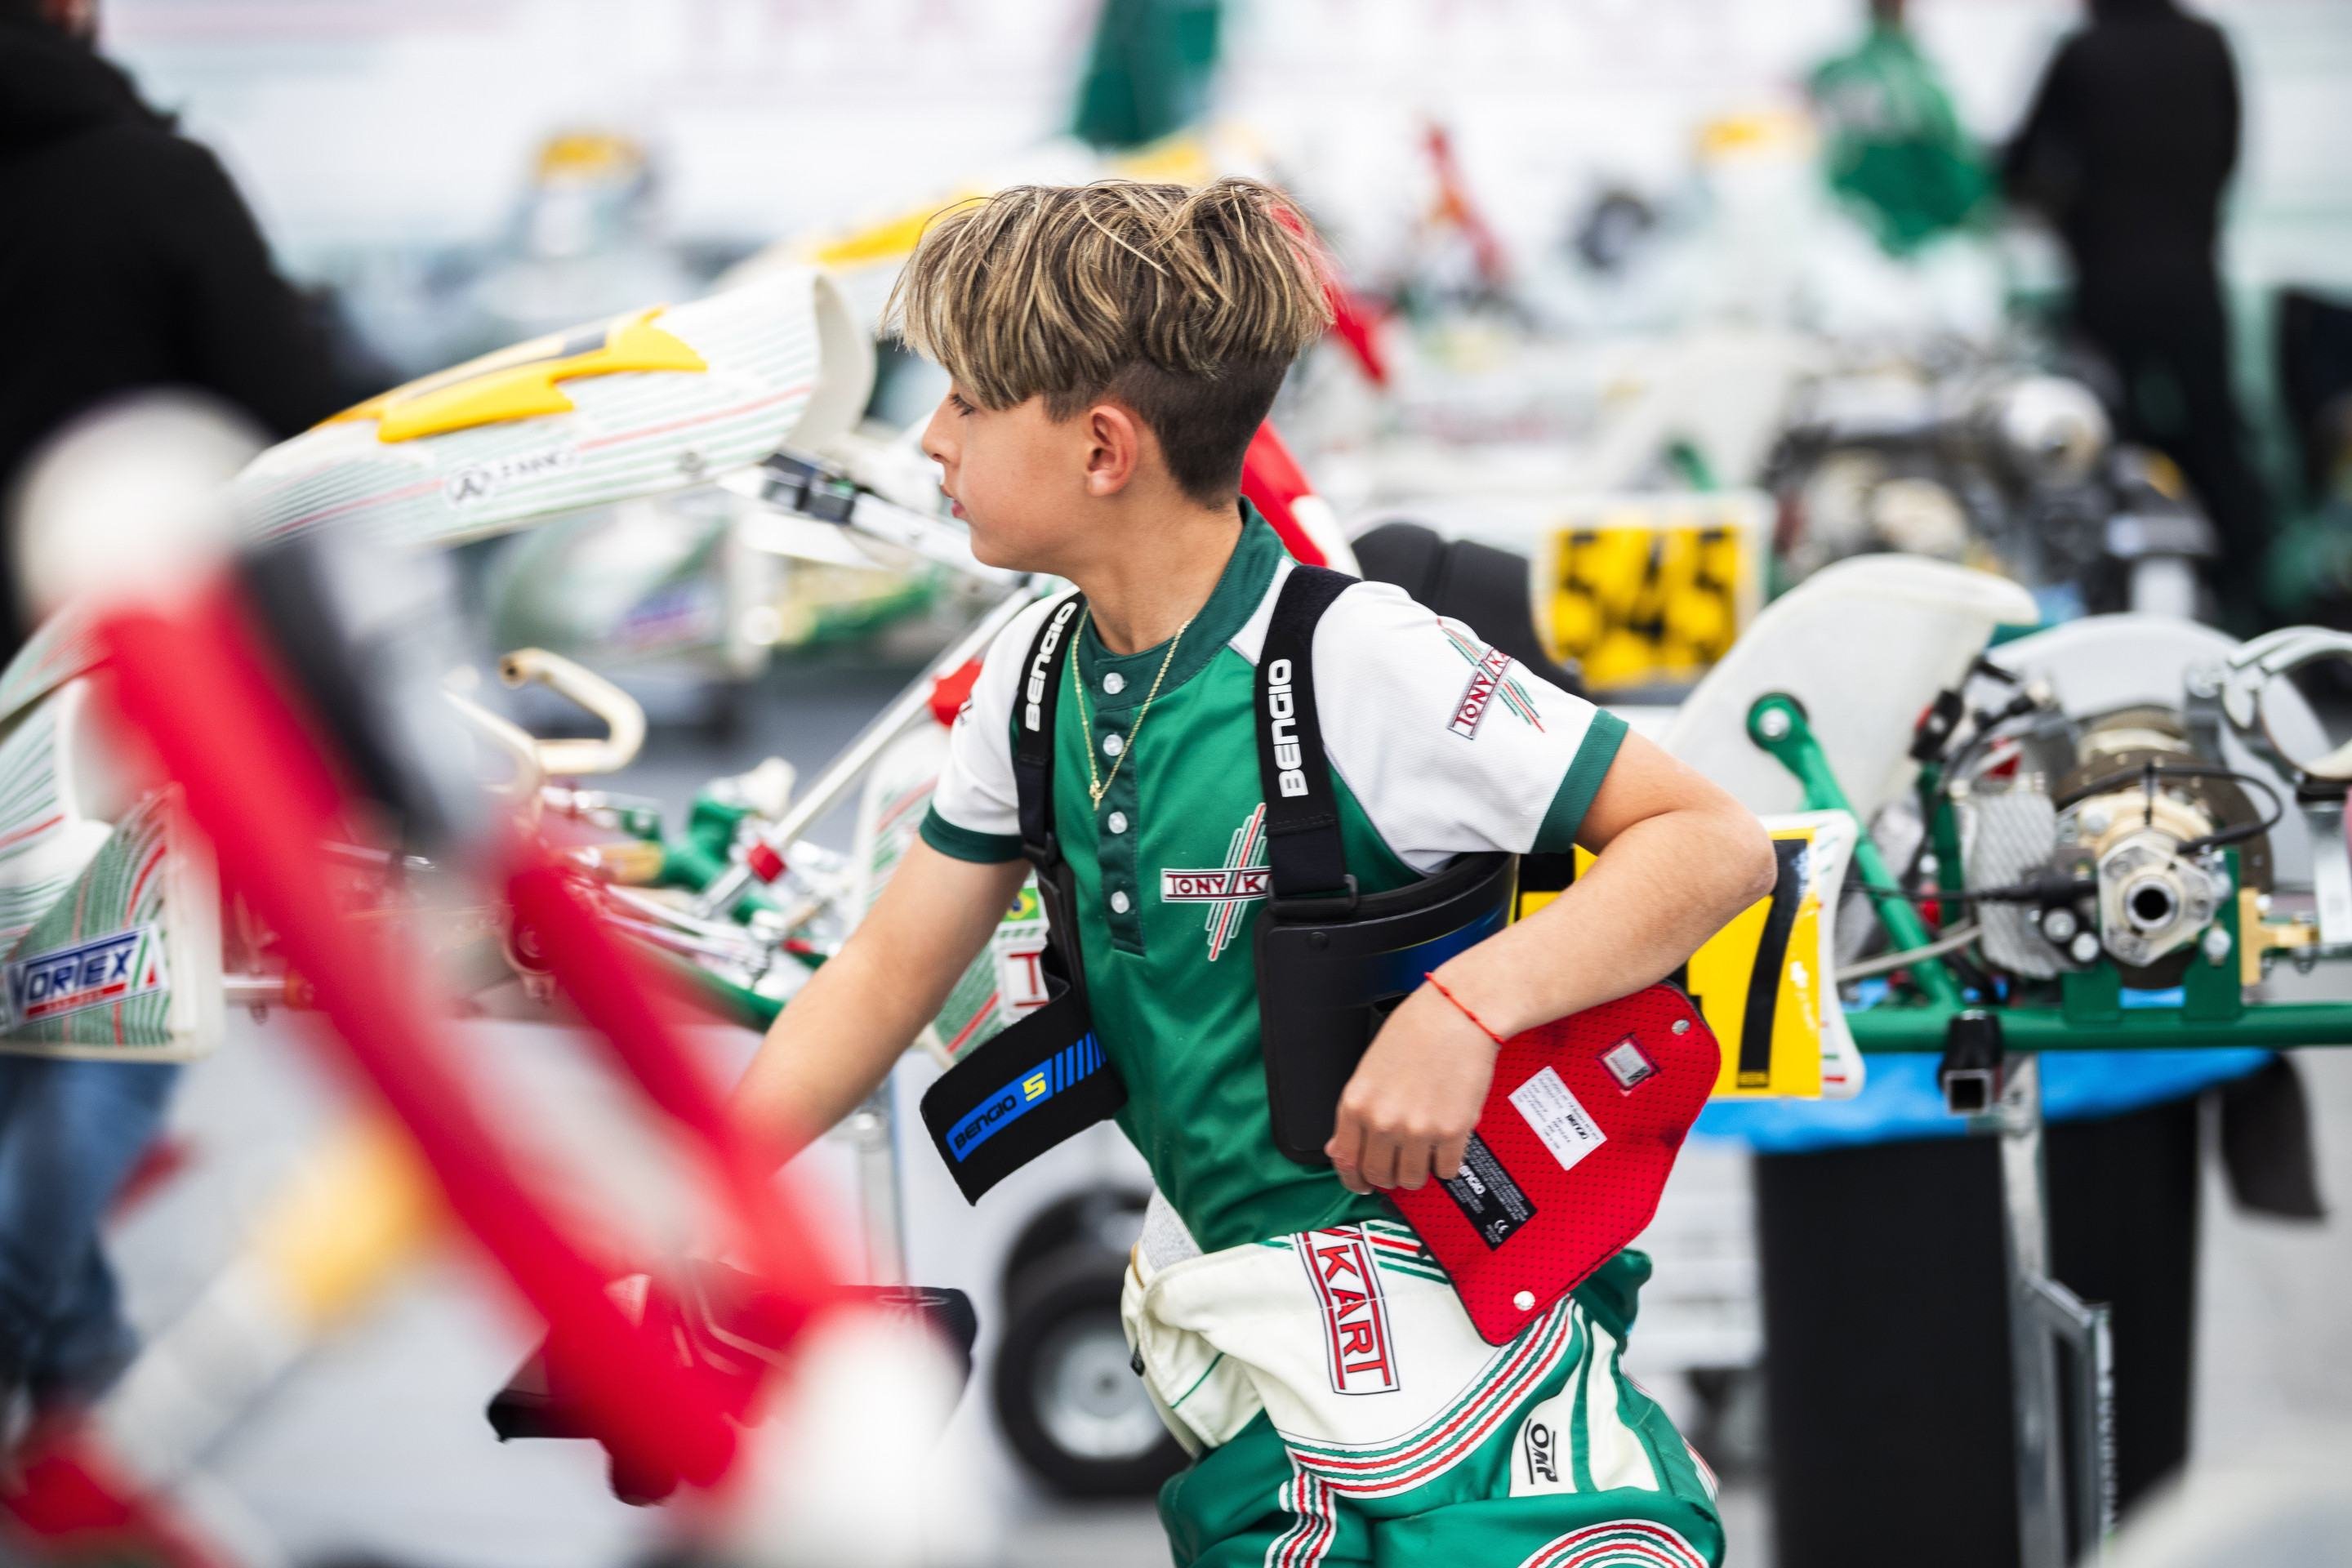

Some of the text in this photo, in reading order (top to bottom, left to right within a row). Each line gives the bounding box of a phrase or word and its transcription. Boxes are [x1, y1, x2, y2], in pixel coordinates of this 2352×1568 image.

[1452, 671, 1496, 728] TONY
[1165, 874, 1226, 894] TONY
[7, 936, 137, 1018] VORTEX
[1022, 1071, 1046, 1102] 5
[1316, 1242, 1392, 1386] KART
[1530, 1423, 1558, 1482] OMP
